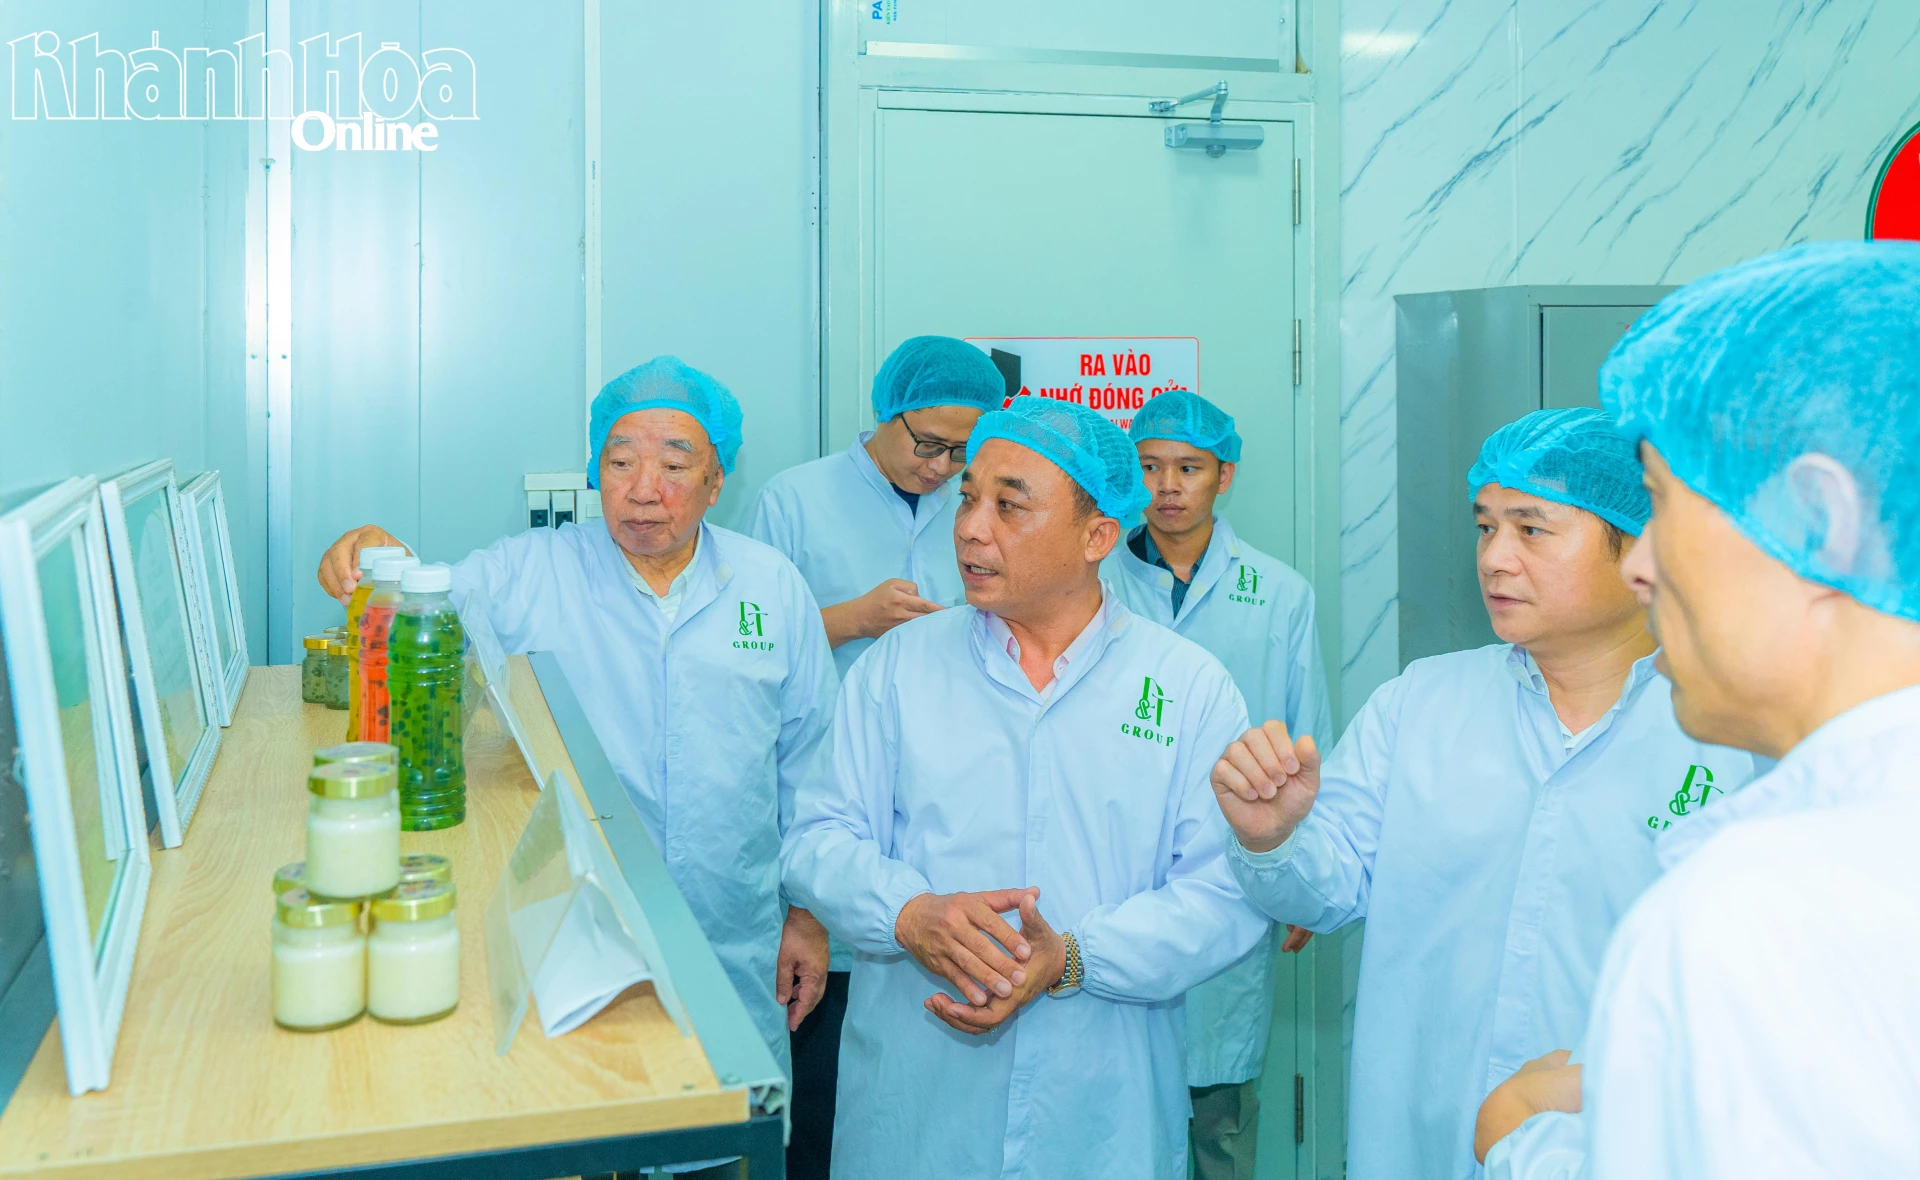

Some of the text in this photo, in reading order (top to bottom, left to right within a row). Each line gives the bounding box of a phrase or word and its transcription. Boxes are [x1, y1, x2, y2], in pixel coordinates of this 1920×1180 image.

[1080, 348, 1151, 376] RA VÀO
[1088, 382, 1144, 410] ĐÓNG
[1229, 593, 1266, 606] GROUP
[732, 640, 775, 652] GROUP
[1120, 723, 1175, 747] GROUP
